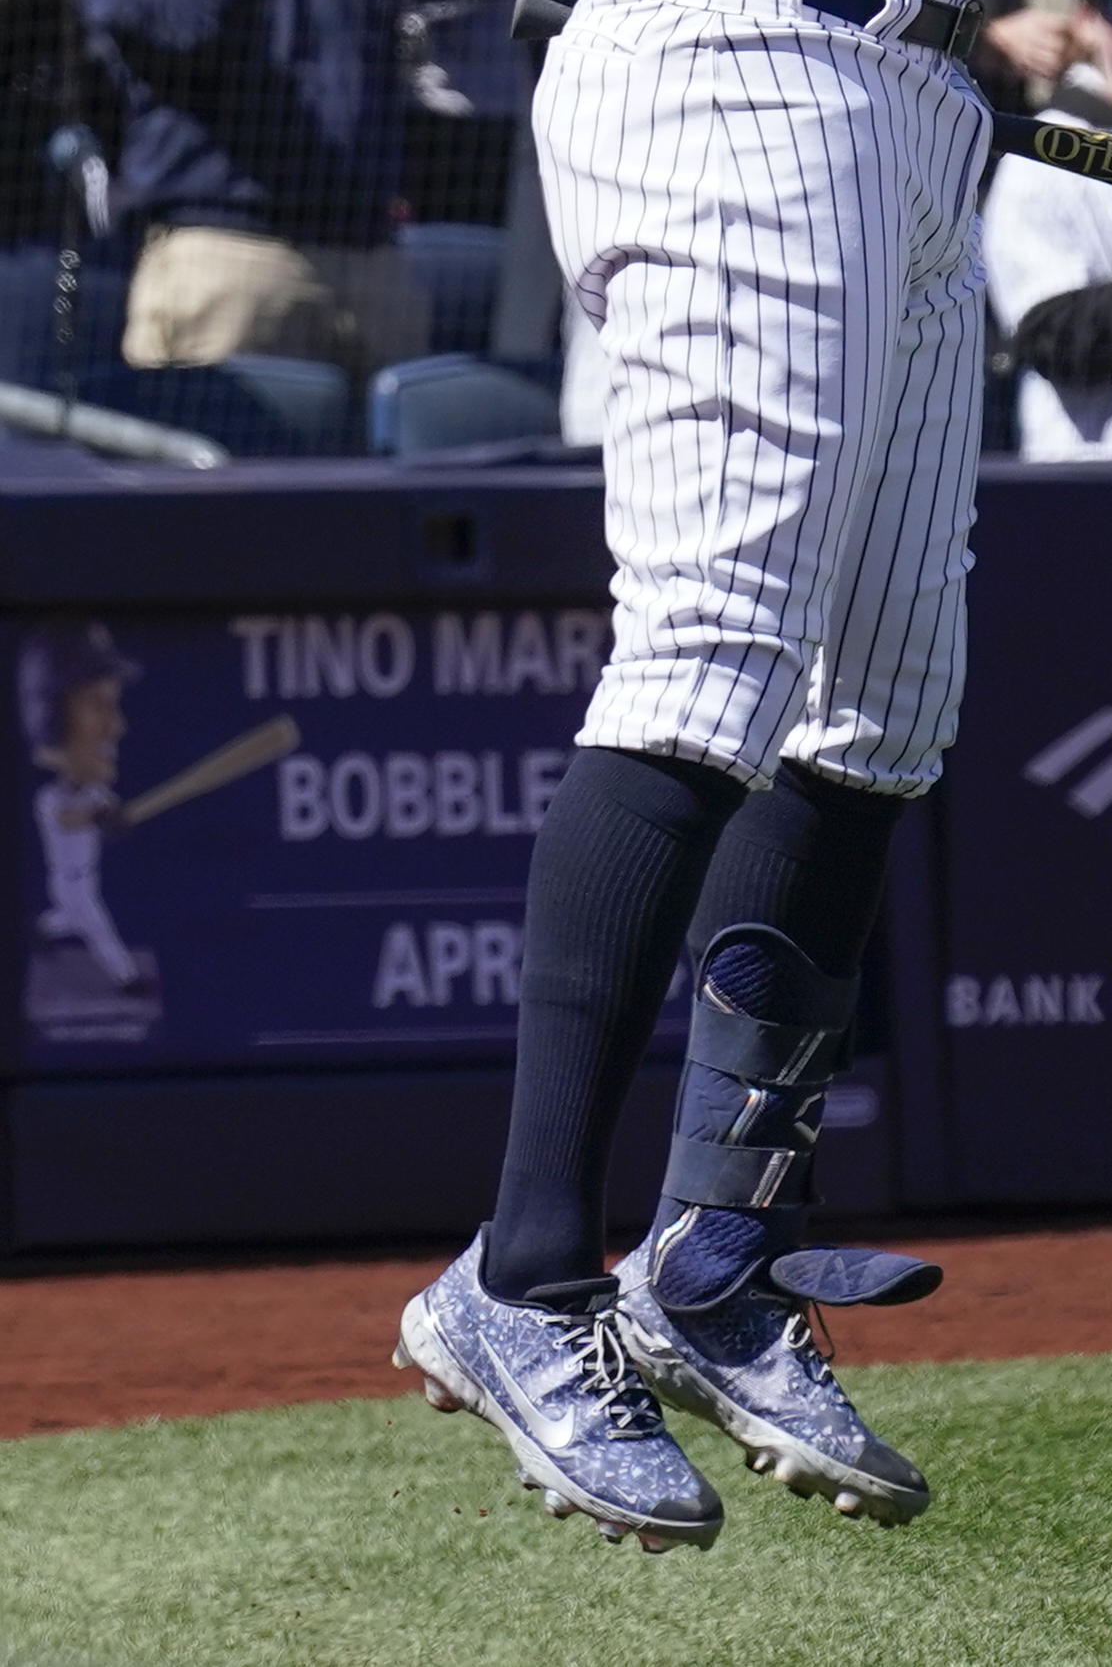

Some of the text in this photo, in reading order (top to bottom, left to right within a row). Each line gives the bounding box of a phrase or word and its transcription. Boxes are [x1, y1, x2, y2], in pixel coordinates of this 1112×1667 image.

[231, 607, 612, 700] TINO MAR
[278, 748, 578, 841] BOBBLE
[371, 920, 526, 1010] APR
[946, 972, 1105, 1027] BANK
